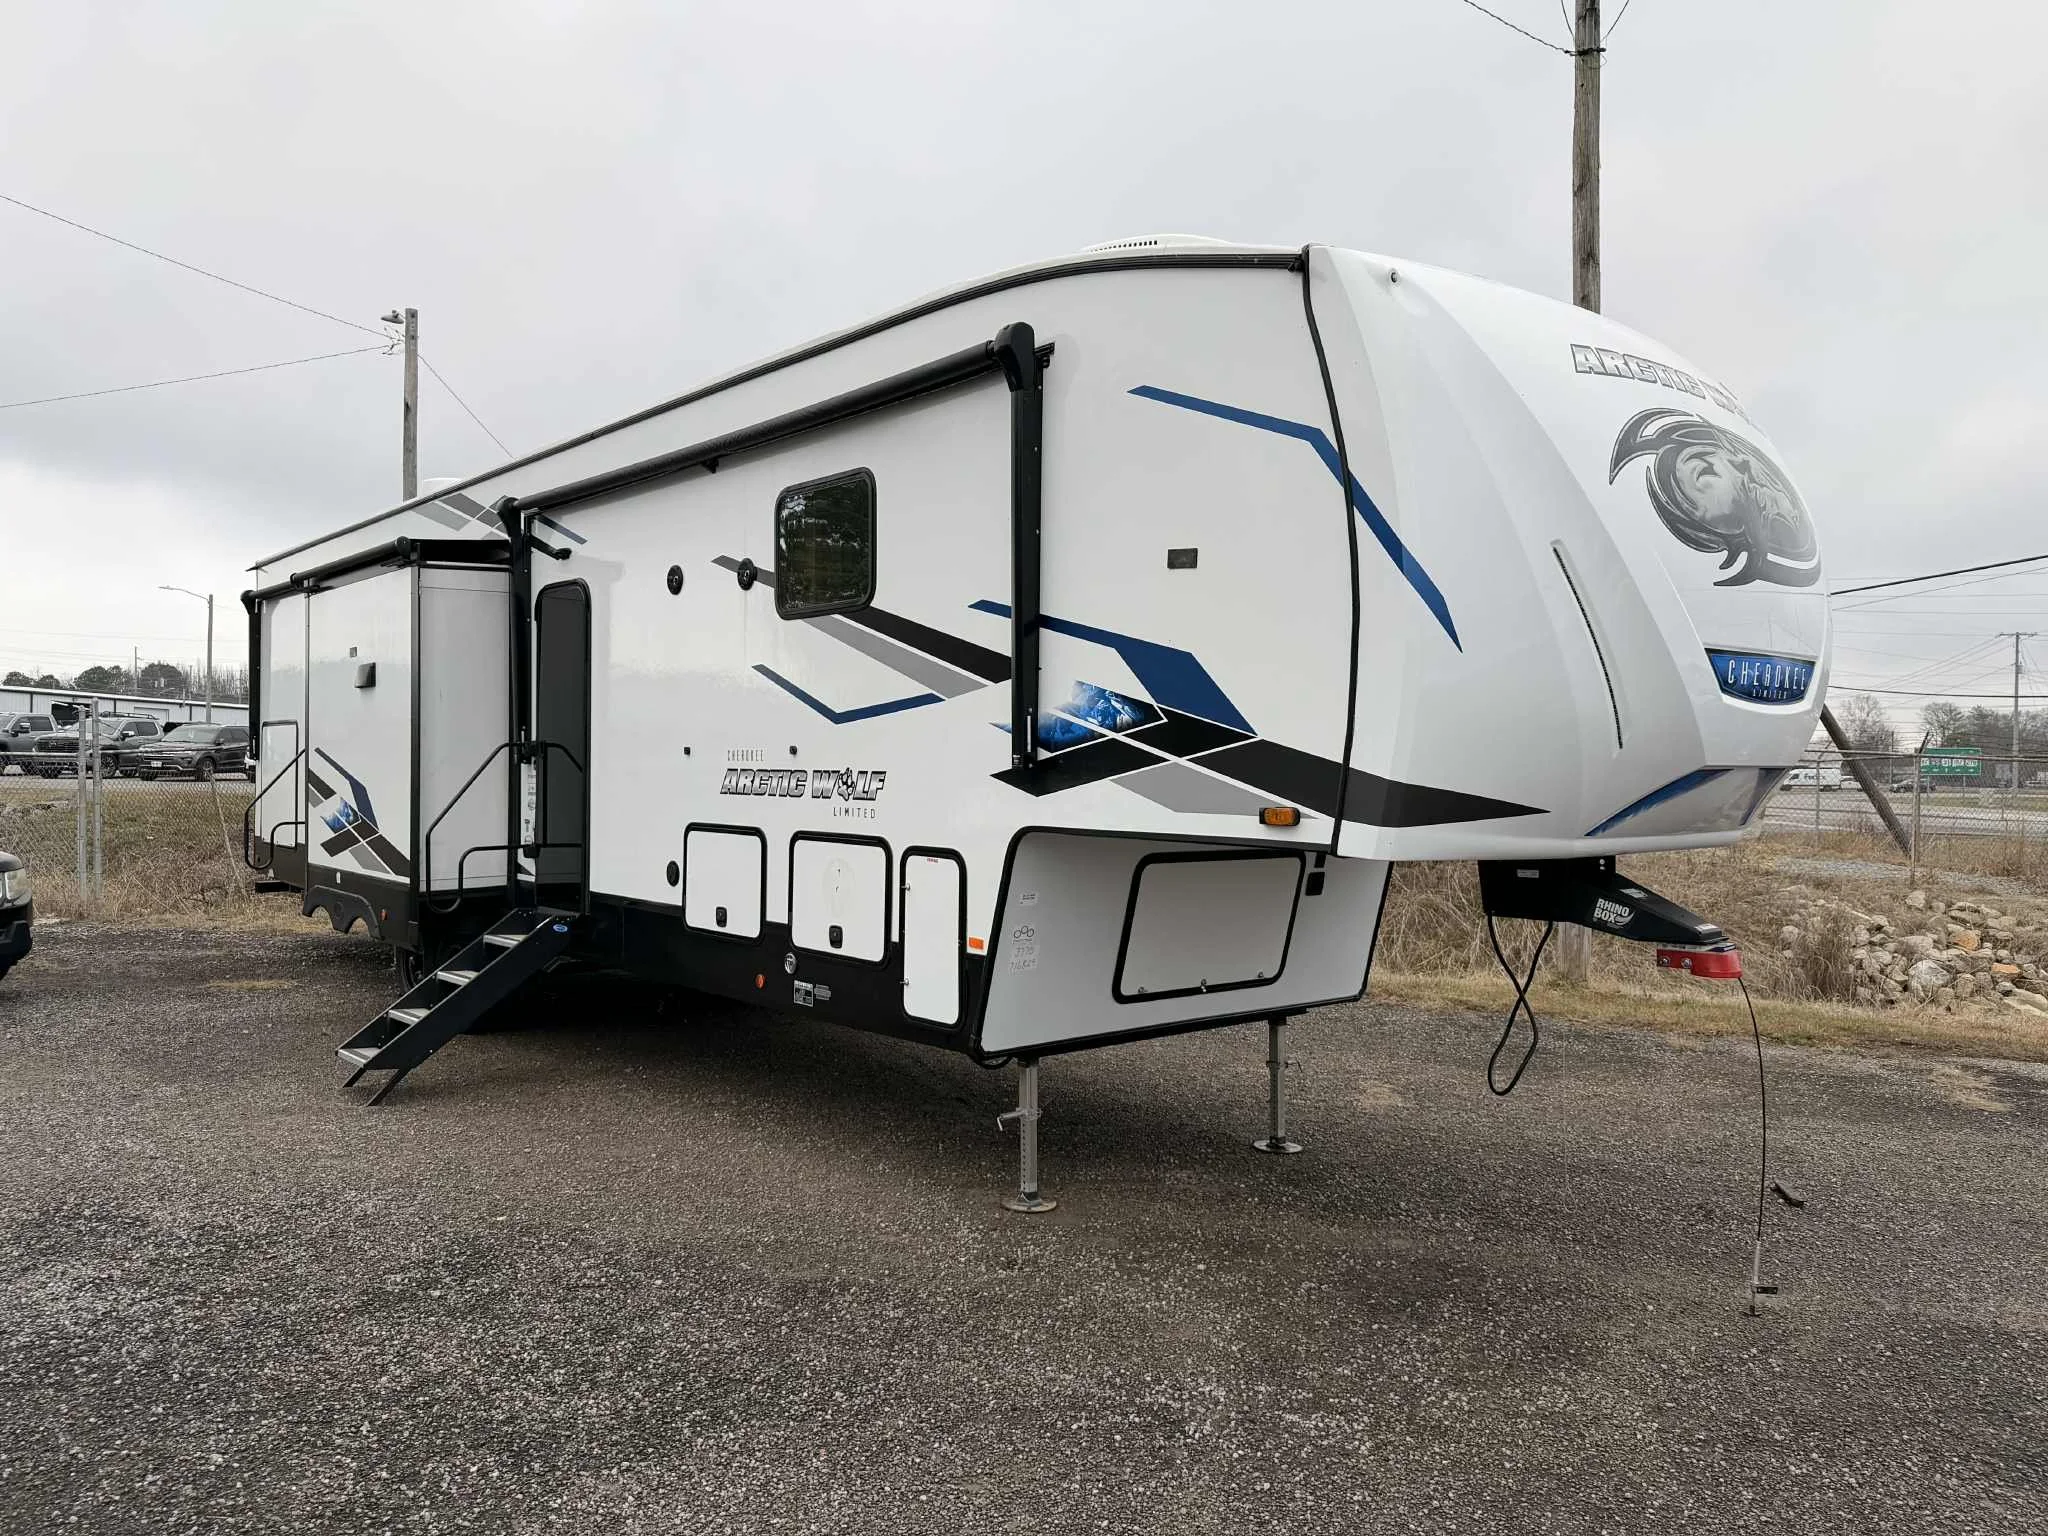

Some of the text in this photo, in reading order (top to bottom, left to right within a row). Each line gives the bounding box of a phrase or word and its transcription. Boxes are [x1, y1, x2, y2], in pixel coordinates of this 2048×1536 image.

[1570, 343, 1706, 399] ARCTIC
[1727, 659, 1807, 690] CHEROKEE
[720, 768, 808, 798] ARCTIC
[833, 807, 876, 819] LIMITED
[1593, 907, 1618, 924] BOX
[1596, 898, 1630, 917] RHINO
